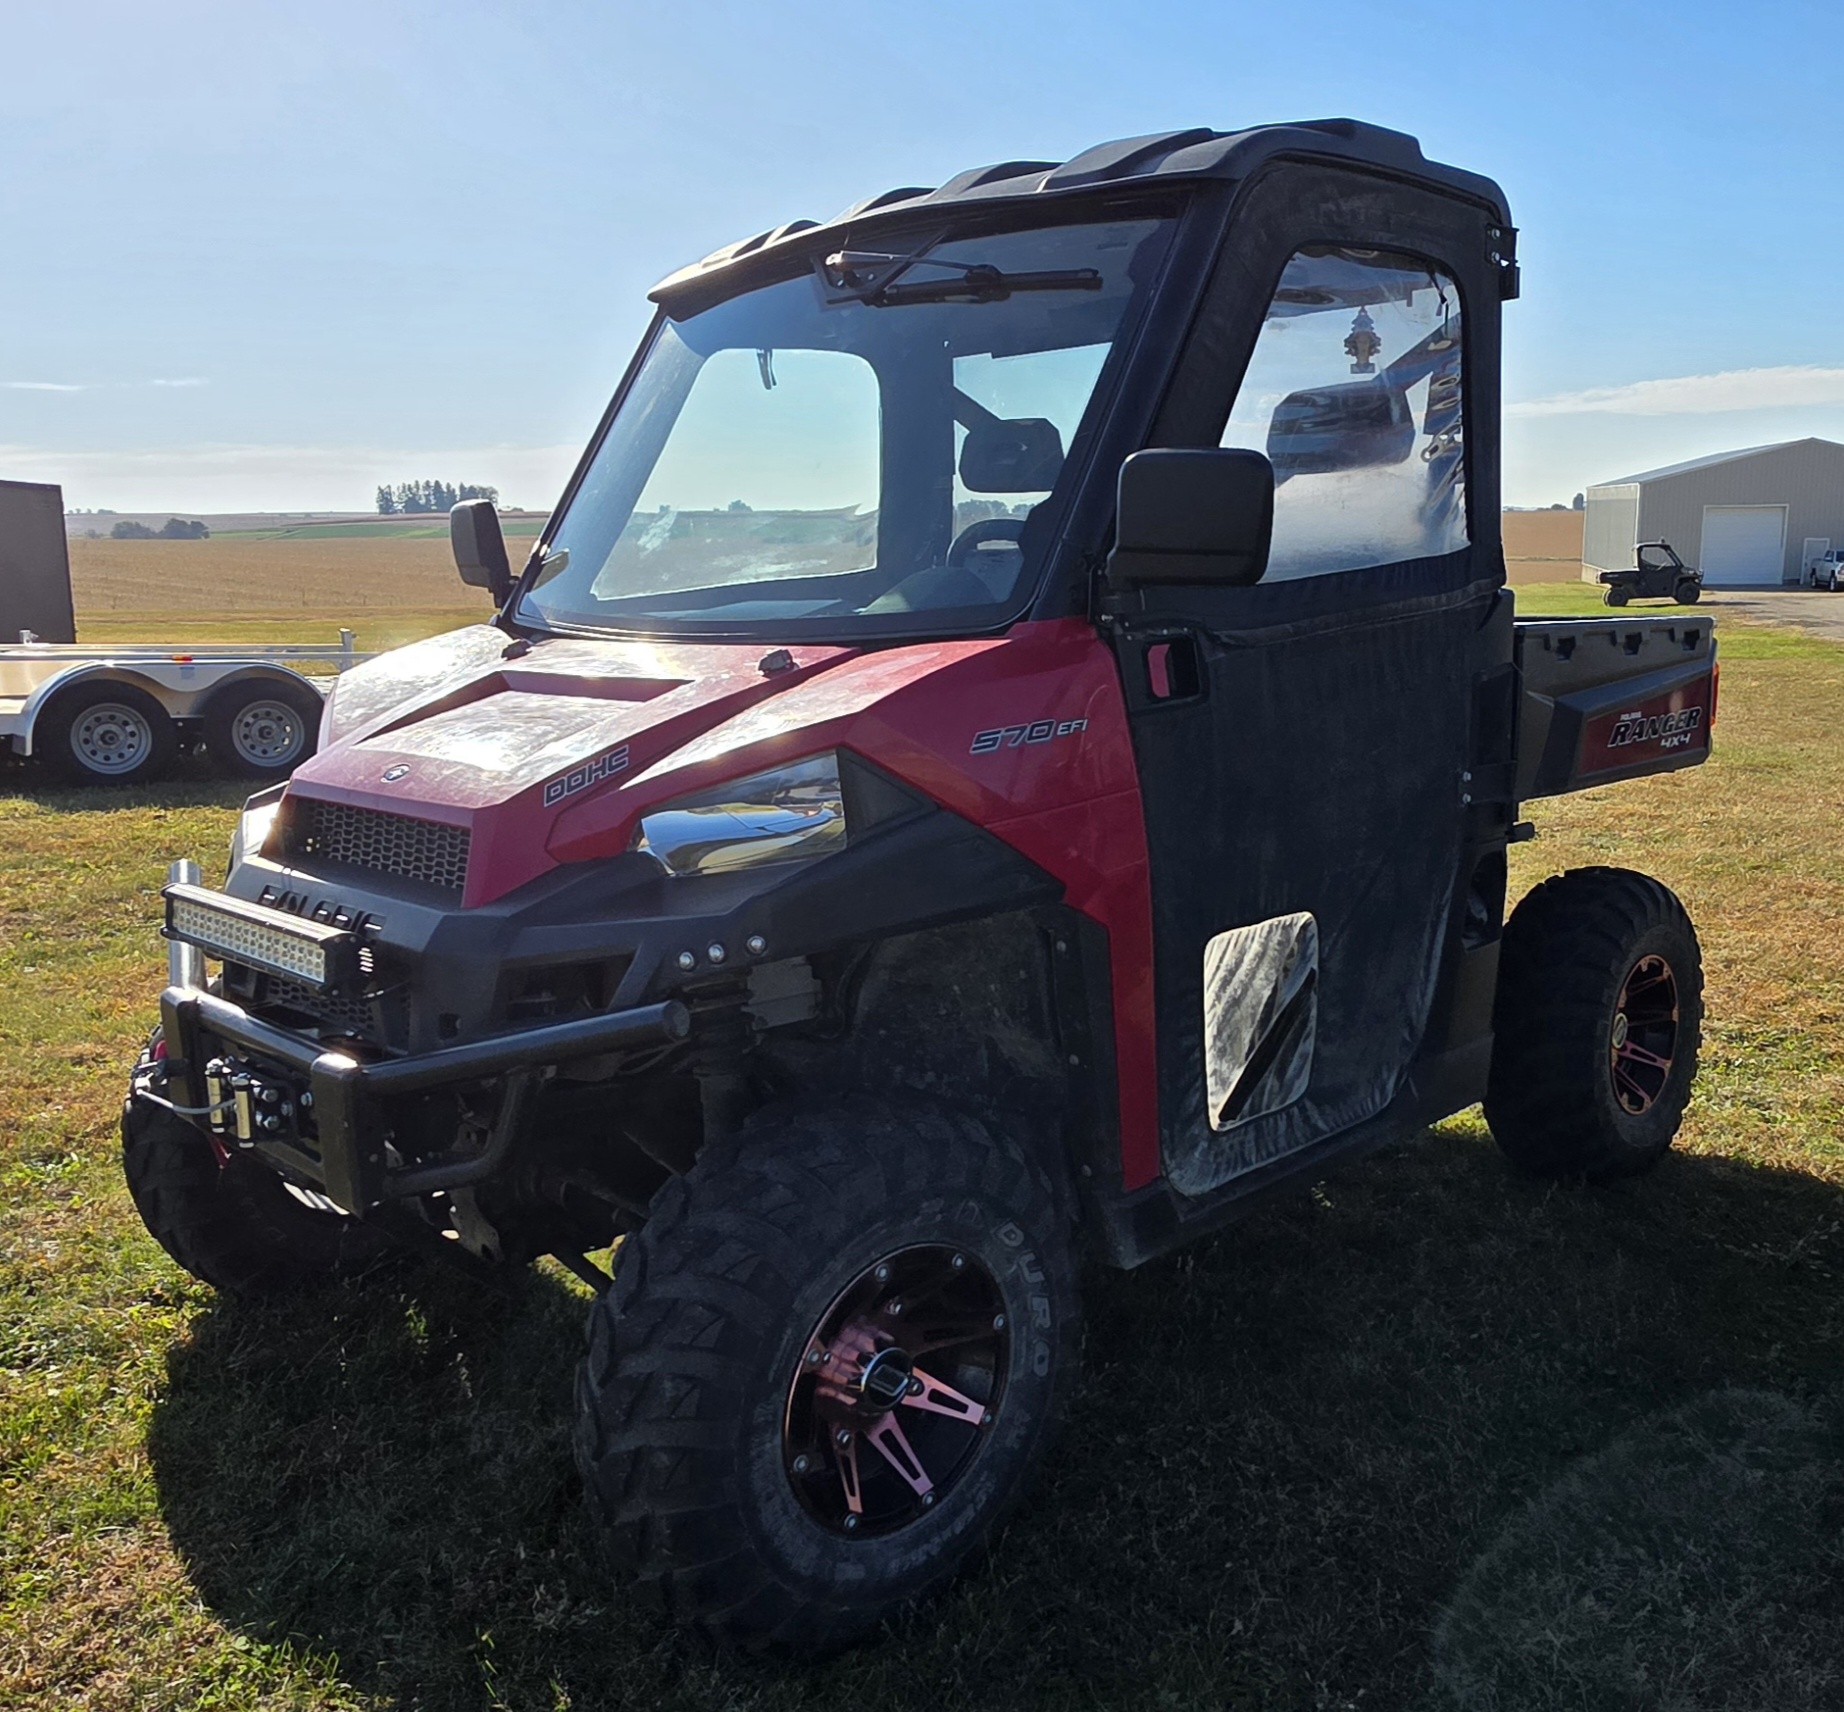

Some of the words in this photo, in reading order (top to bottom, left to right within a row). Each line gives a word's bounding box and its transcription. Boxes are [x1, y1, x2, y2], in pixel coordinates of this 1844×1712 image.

[969, 719, 1056, 754] 570
[1056, 719, 1088, 736] EFI
[1607, 706, 1702, 748] RANGER
[543, 744, 629, 808] DOHC
[998, 1220, 1051, 1378] DURO
